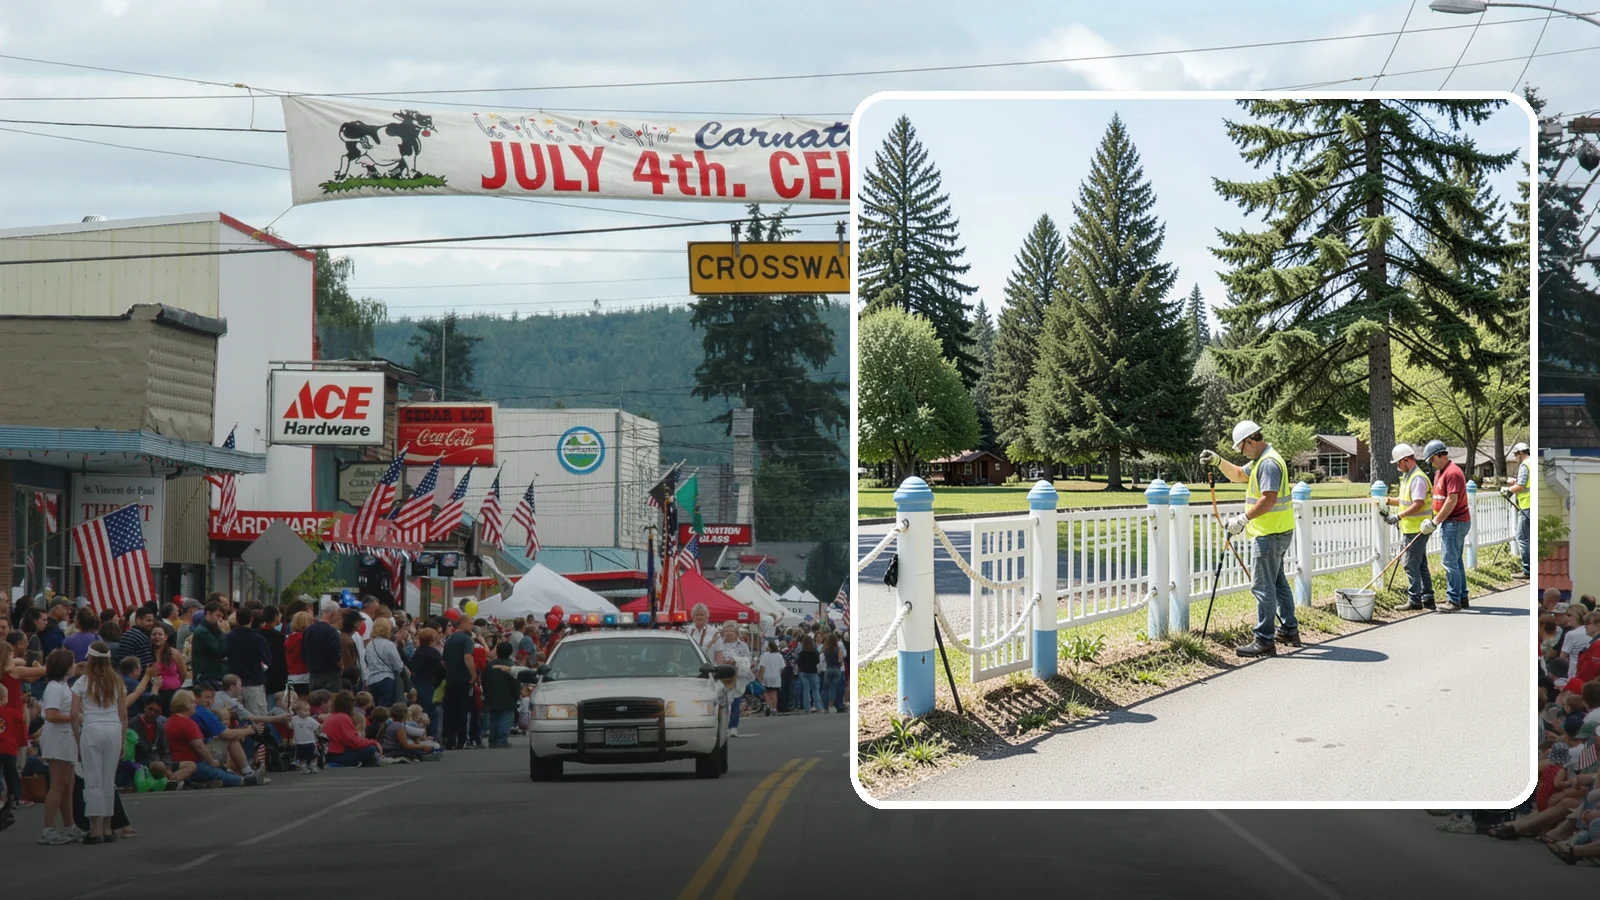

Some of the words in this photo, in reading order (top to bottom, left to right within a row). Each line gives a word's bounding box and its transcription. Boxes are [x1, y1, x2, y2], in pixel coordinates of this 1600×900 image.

[694, 121, 850, 150] Carnat
[481, 141, 605, 193] JULY
[632, 150, 746, 197] 4th.
[696, 254, 850, 280] CROSSWA
[283, 380, 373, 420] ACE
[406, 409, 453, 422] CEDAR
[461, 409, 485, 422] LOG
[283, 421, 371, 437] Hardware
[416, 428, 477, 447] Coca-Cola
[353, 467, 385, 483] Simpl
[95, 484, 124, 495] Vincent
[126, 485, 136, 495] de
[137, 485, 155, 495] Paul
[212, 516, 331, 536] HARDARE
[688, 526, 742, 535] CRNATION
[699, 535, 731, 544] GLASS
